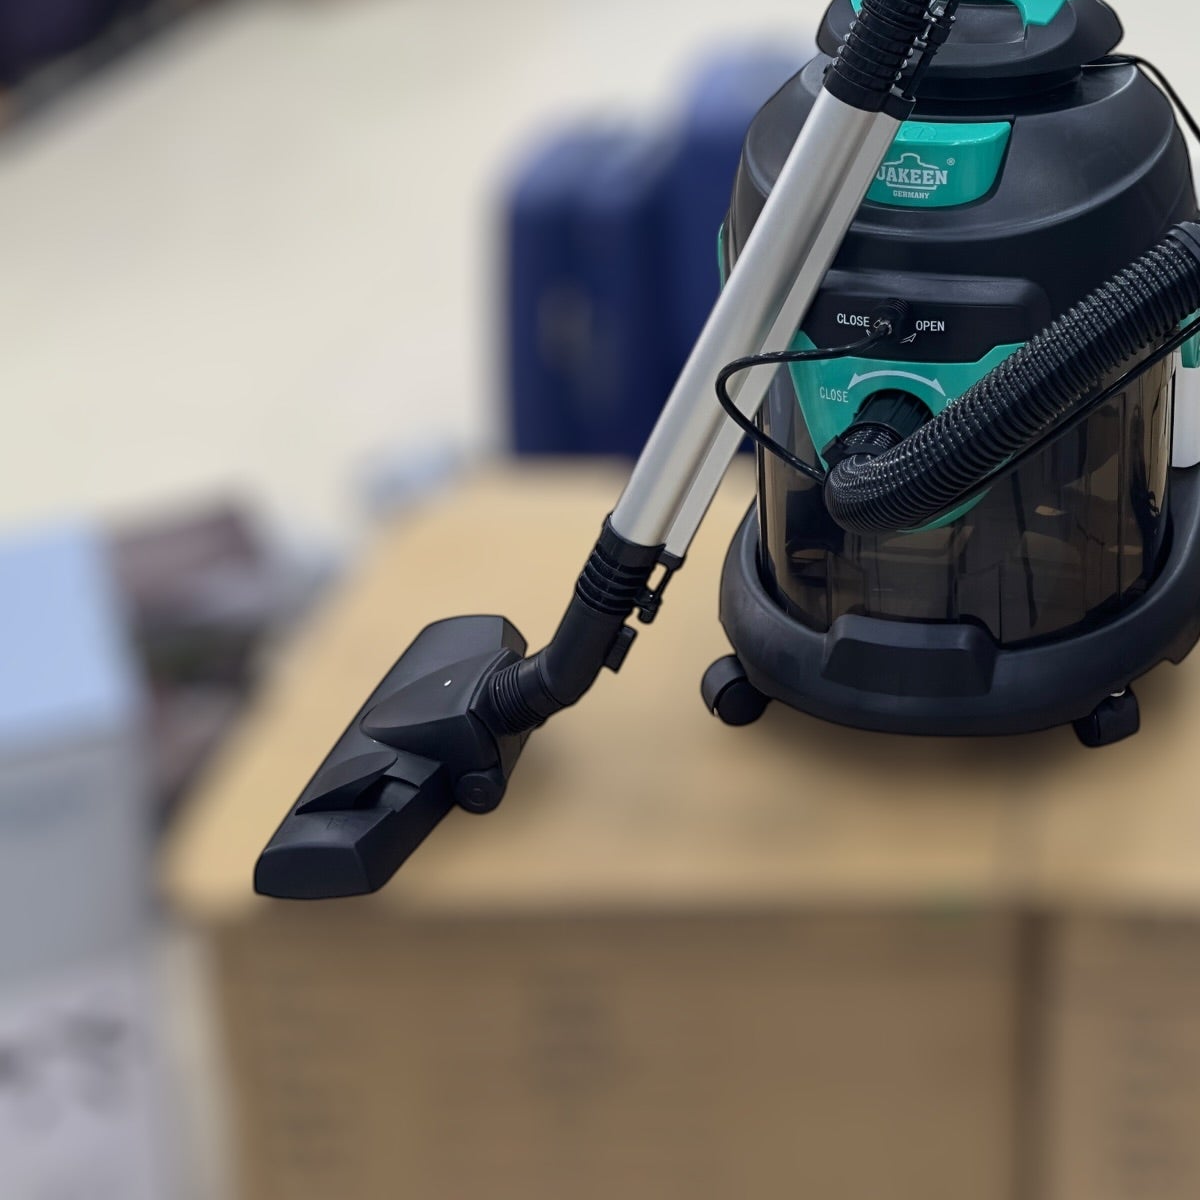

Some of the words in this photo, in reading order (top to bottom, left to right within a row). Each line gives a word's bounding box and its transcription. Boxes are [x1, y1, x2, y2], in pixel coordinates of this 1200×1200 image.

[876, 166, 948, 185] JAKEEN
[893, 190, 930, 199] GERMANY
[836, 313, 870, 327] CLOSE
[915, 320, 945, 332] OPEN
[819, 386, 849, 403] CLOSE
